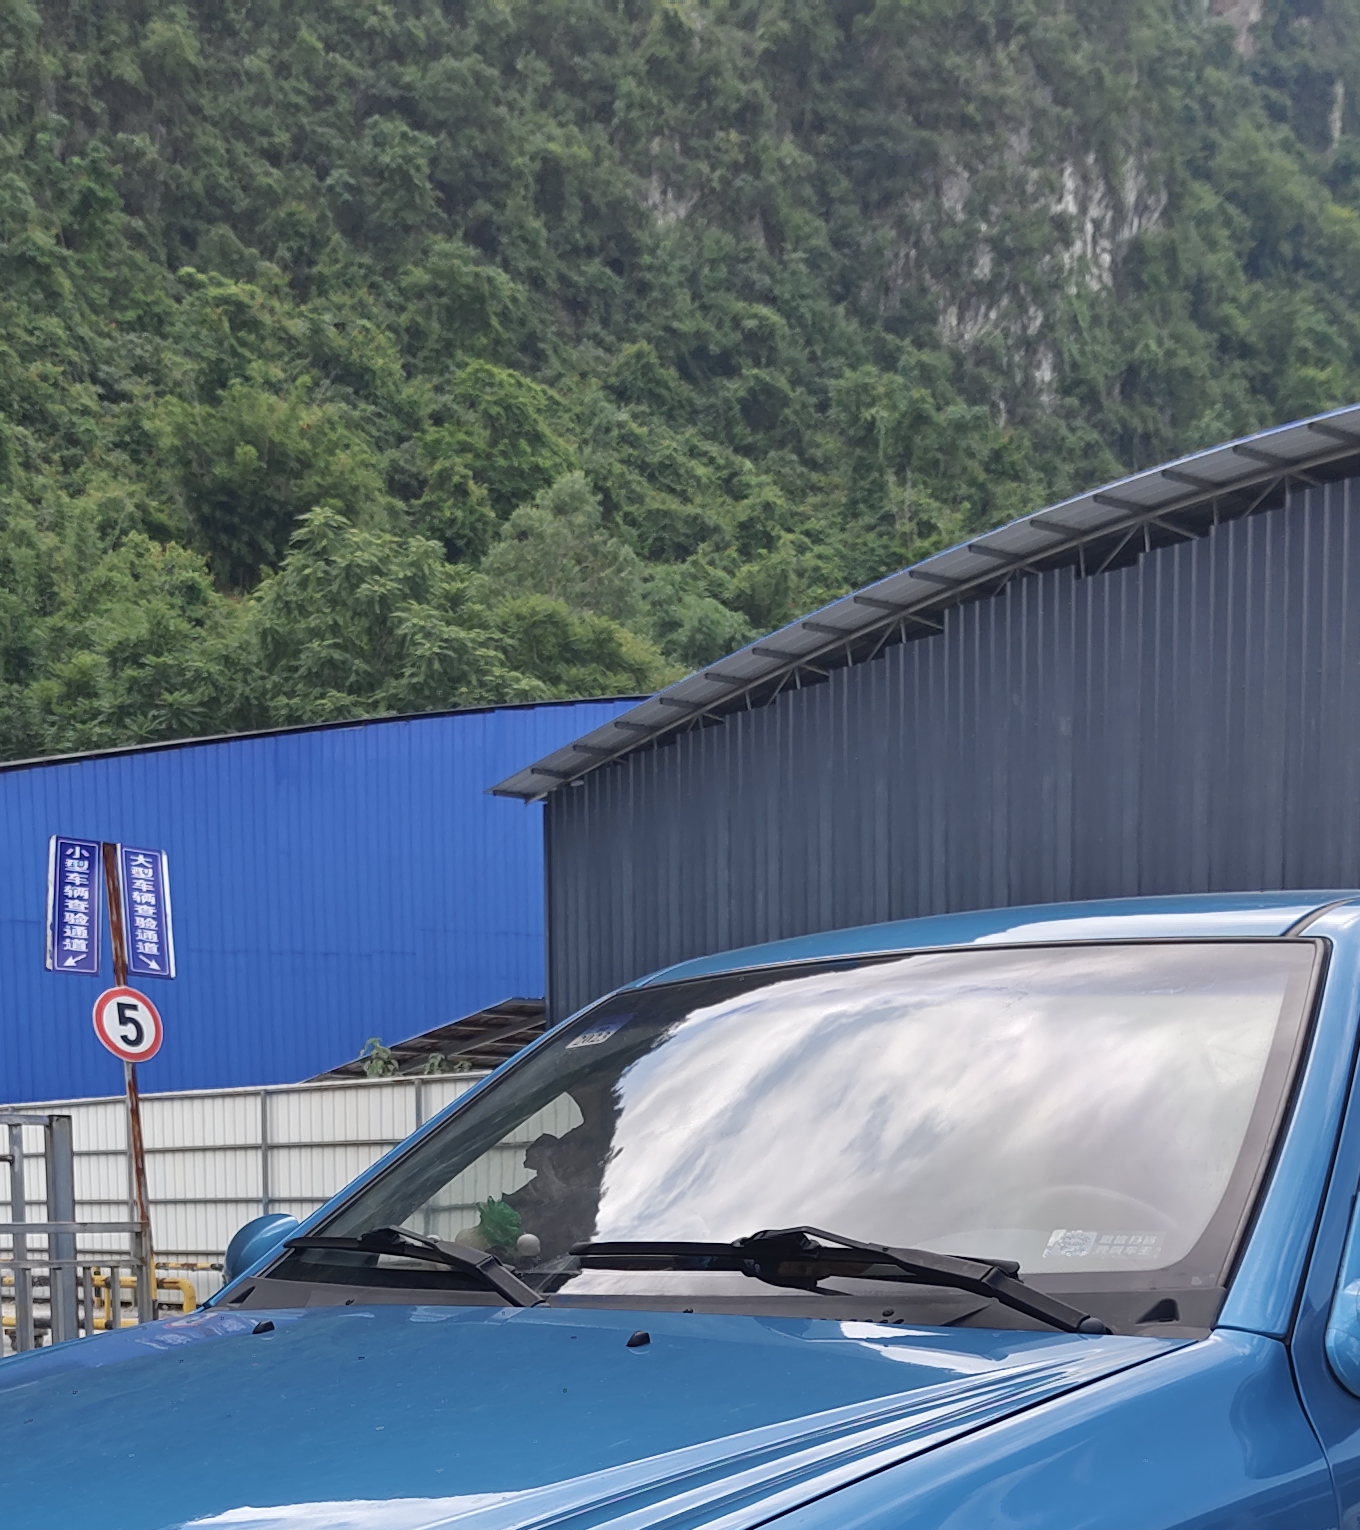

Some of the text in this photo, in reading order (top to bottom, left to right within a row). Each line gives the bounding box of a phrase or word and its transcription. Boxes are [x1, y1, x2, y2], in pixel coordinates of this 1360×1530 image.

[62, 846, 90, 952] 小型车辆查验通道
[130, 854, 160, 955] 大型车辆查验通道
[116, 1002, 144, 1047] 5
